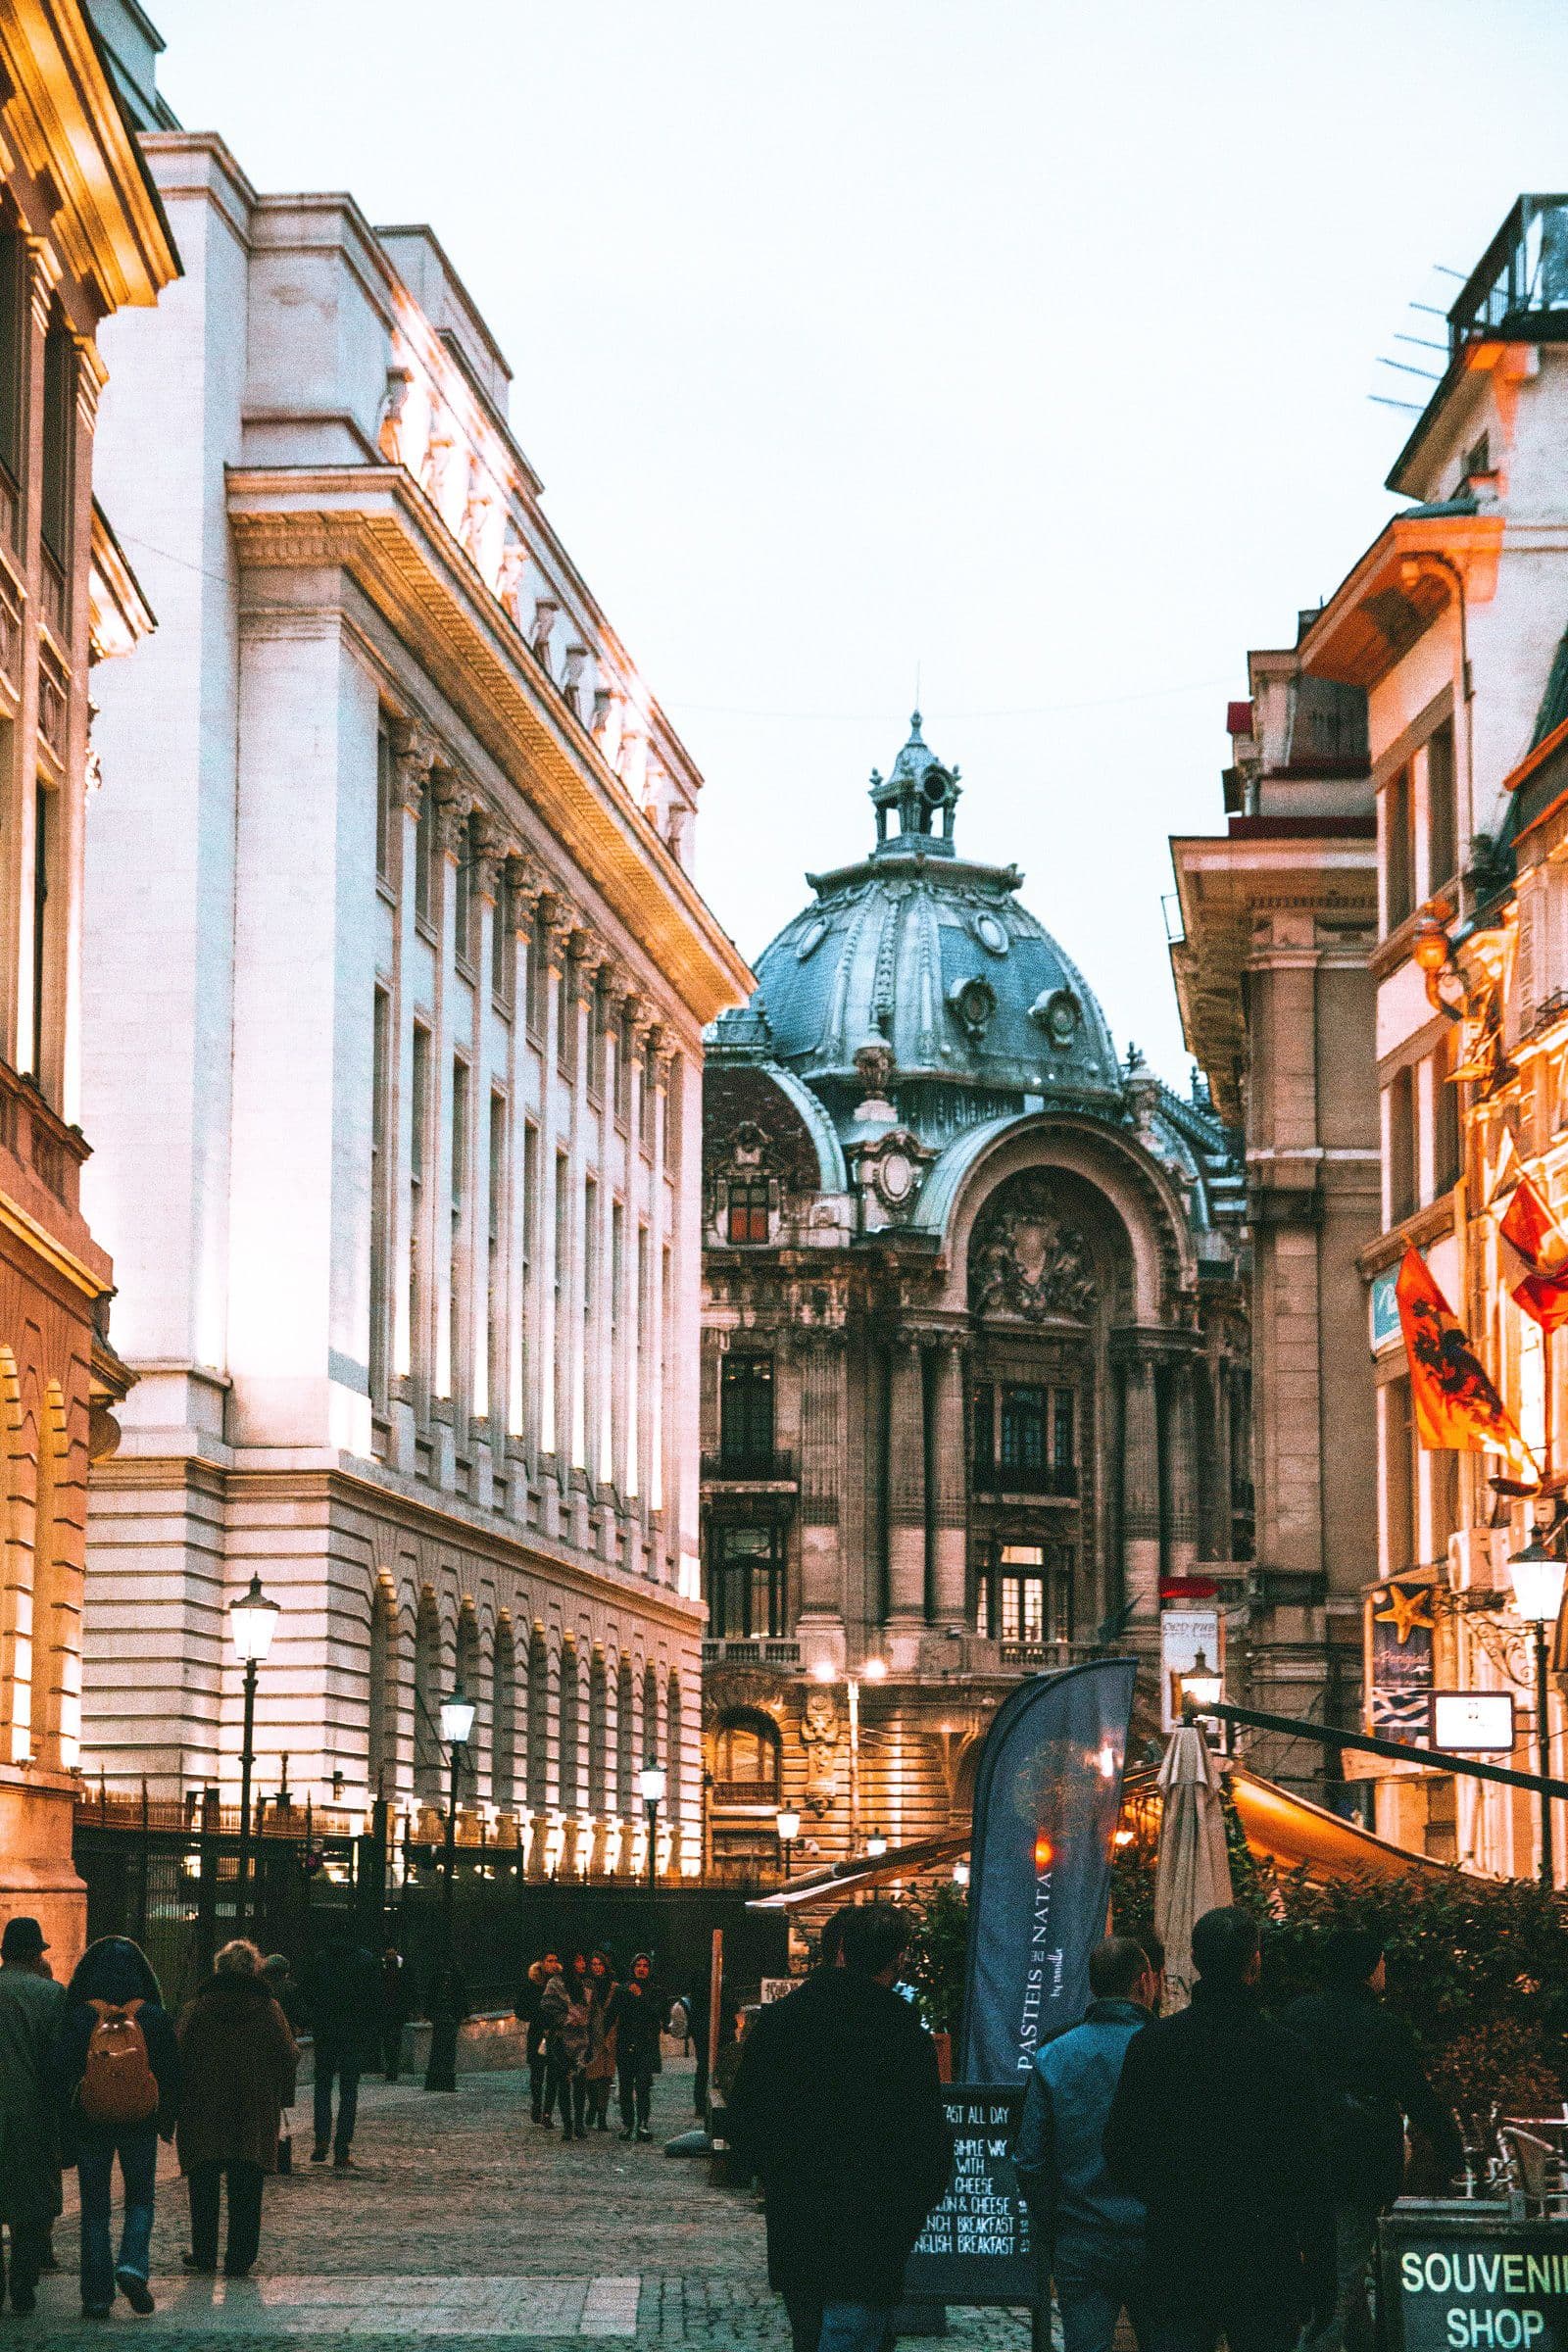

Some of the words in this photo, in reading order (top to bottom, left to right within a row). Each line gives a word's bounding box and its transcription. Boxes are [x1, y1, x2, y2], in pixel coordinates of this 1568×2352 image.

[1032, 1873, 1053, 1943] NATA
[1031, 1950, 1045, 1962] DE
[1050, 1984, 1063, 1997] by
[1017, 1969, 1043, 2070] PASTEIS
[968, 2106, 986, 2125] ALL
[990, 2107, 1009, 2125] DAY
[988, 2139, 1007, 2156] WAY
[956, 2158, 985, 2175] WITH
[955, 2177, 994, 2195] CHEESE
[958, 2196, 968, 2212] &
[971, 2197, 1010, 2215] CHEESE
[957, 2216, 1014, 2233] BREAKFAST
[911, 2235, 952, 2253] NGLISH
[957, 2235, 1015, 2254] BREAKFAST
[1446, 2308, 1544, 2349] SHOP
